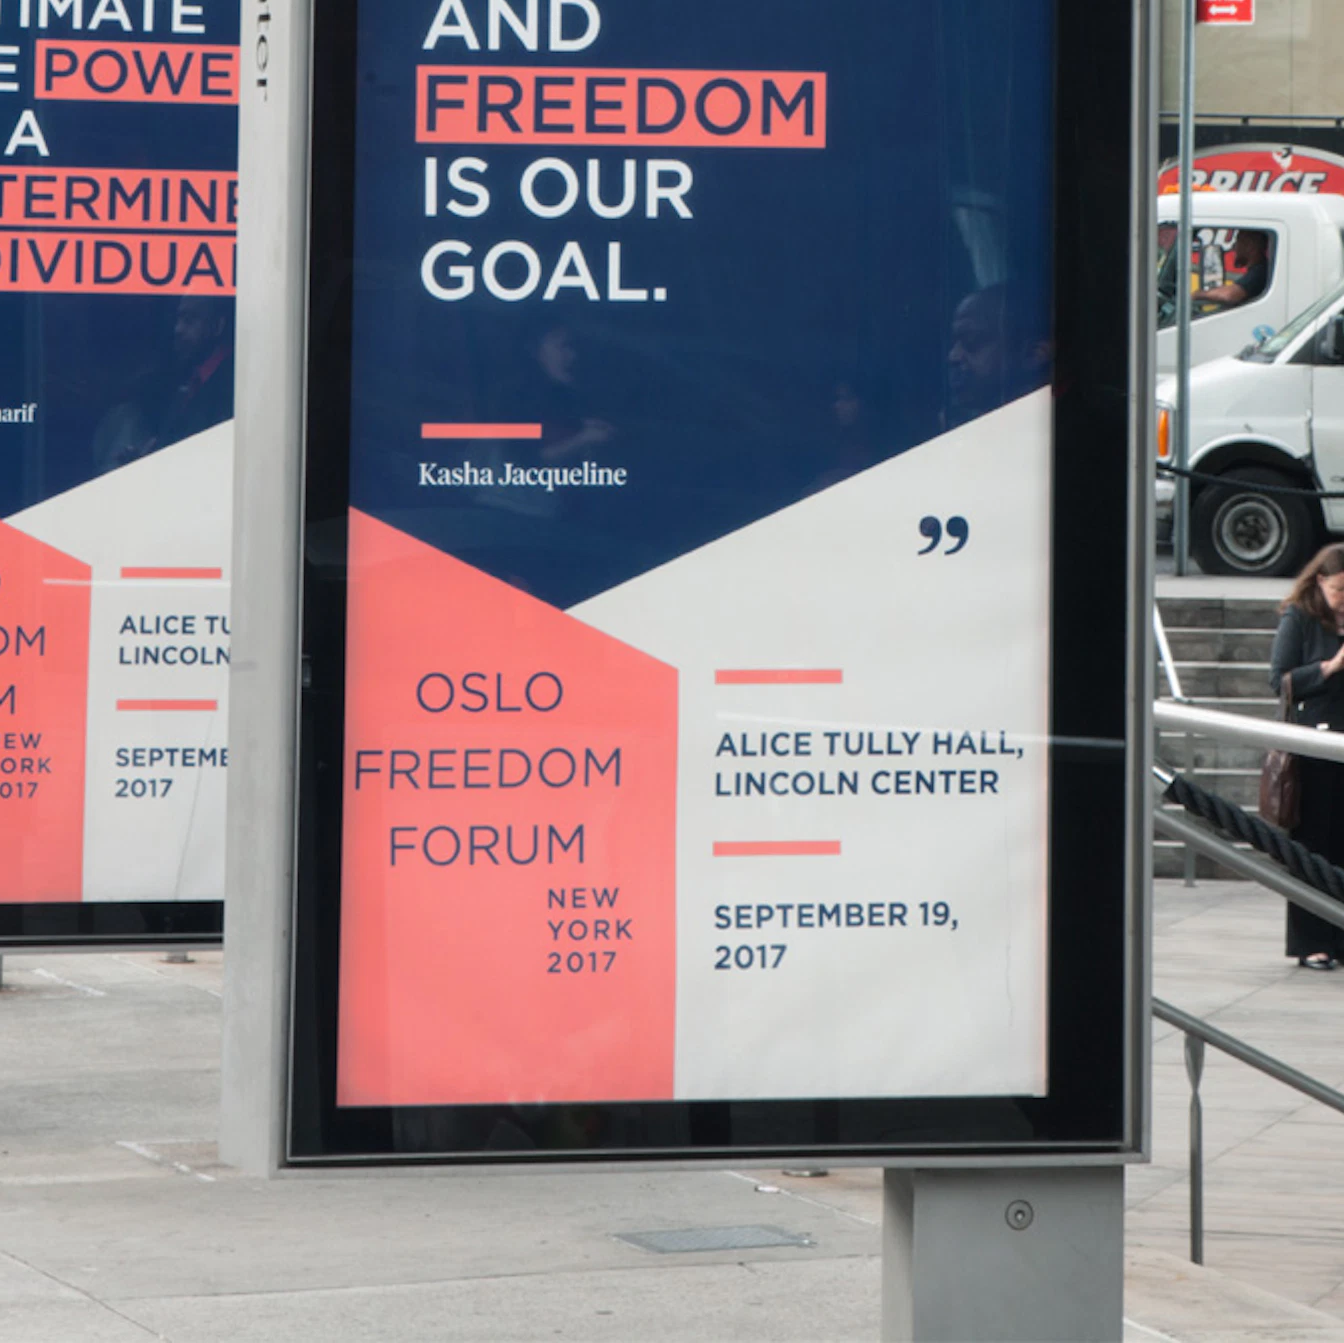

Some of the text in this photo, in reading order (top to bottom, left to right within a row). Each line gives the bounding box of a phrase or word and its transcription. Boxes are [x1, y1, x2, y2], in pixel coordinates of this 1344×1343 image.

[44, 49, 233, 97] POWE
[425, 75, 815, 137] FREEDOM
[4, 109, 49, 156] A
[424, 156, 694, 219] IS OUR
[420, 241, 667, 302] GOAL.
[419, 462, 627, 491] Kasha Jacqueline
[119, 615, 197, 635] ALICE
[119, 646, 231, 666] LINCOLN
[416, 671, 564, 714] OSLO
[715, 730, 1025, 760] ALICE TULLY HALL,
[354, 747, 623, 791] FREEDOM
[714, 769, 999, 798] LINCOLN CENTER
[115, 778, 173, 798] 2017
[389, 824, 585, 867] FORUM
[547, 888, 619, 909] NEW
[547, 918, 633, 941] YORK
[714, 902, 959, 932] SEPTEMBER 19,
[547, 952, 617, 974] 2017
[714, 945, 787, 970] 2017
